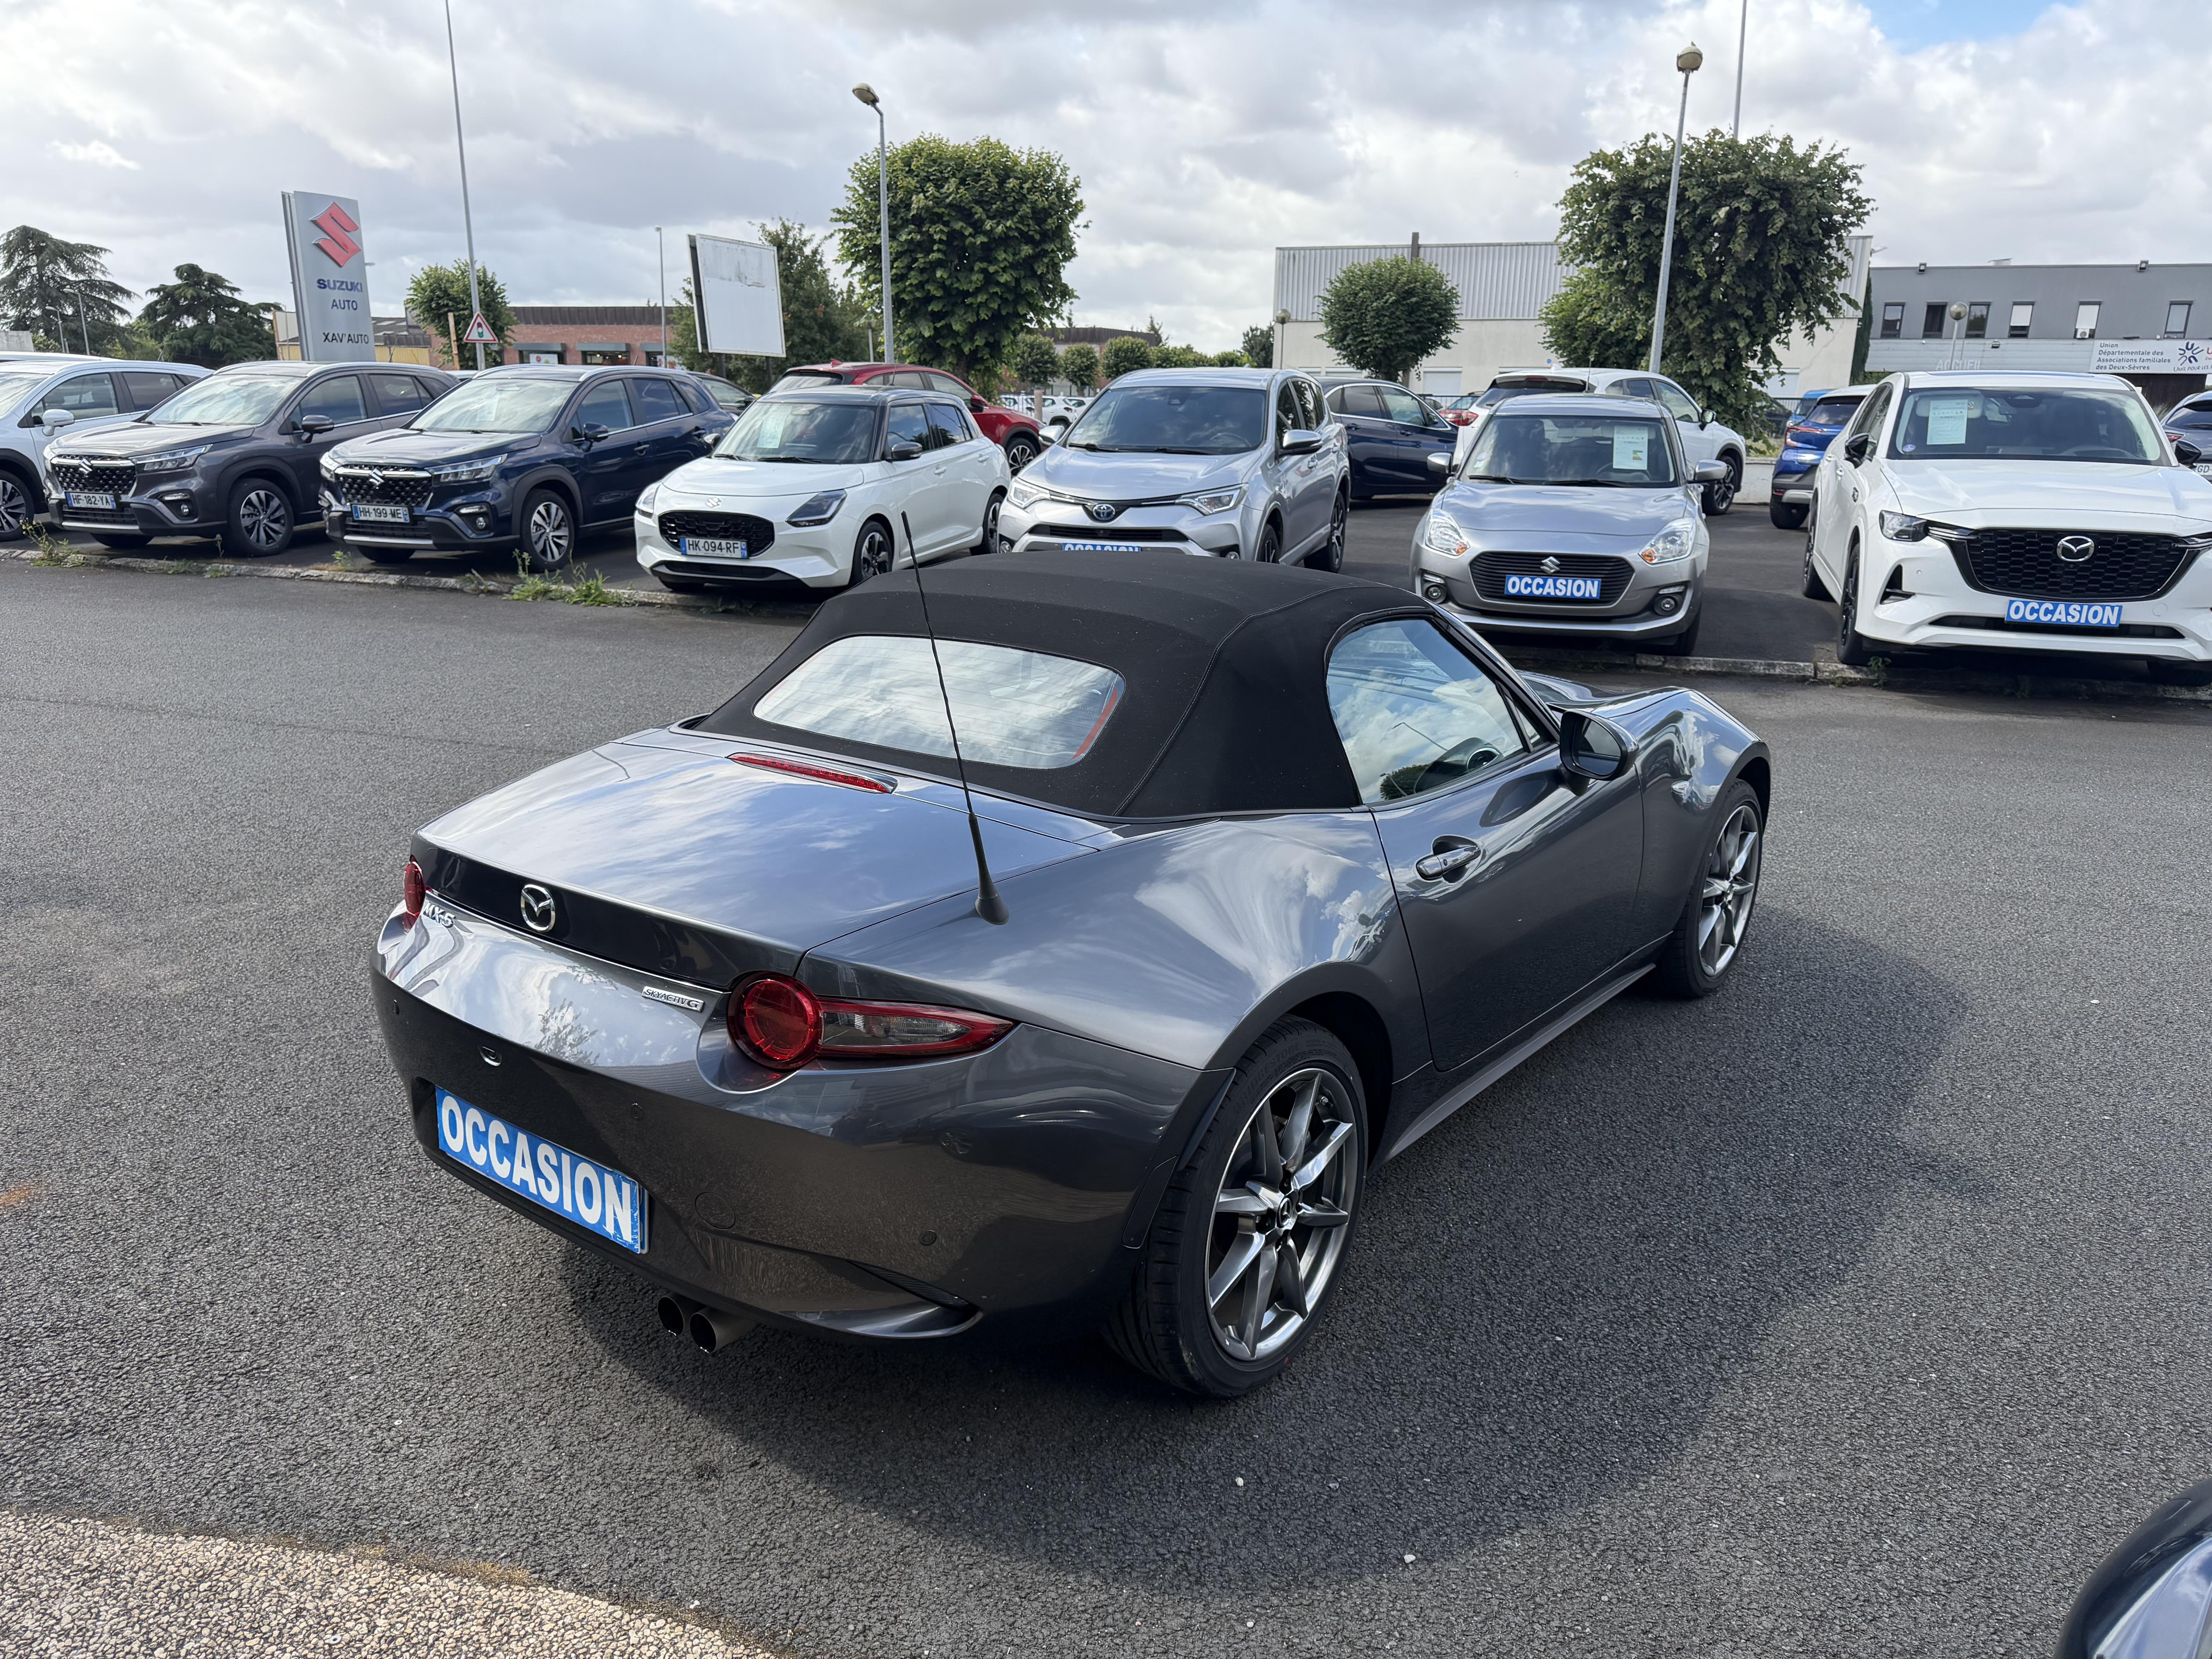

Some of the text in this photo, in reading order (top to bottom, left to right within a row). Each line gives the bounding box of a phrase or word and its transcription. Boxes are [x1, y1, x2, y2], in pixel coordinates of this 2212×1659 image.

[316, 278, 363, 293] SUZUKI
[331, 299, 358, 311] AUTO
[322, 331, 369, 344] XAV'AUTO
[72, 494, 111, 505] HF-182-YA
[687, 539, 739, 553] HK-094-RF
[1507, 577, 1599, 598] OCCASION
[2009, 601, 2119, 625] OCCASION
[423, 902, 456, 928] MX-5
[441, 1096, 632, 1243] OCCASION
